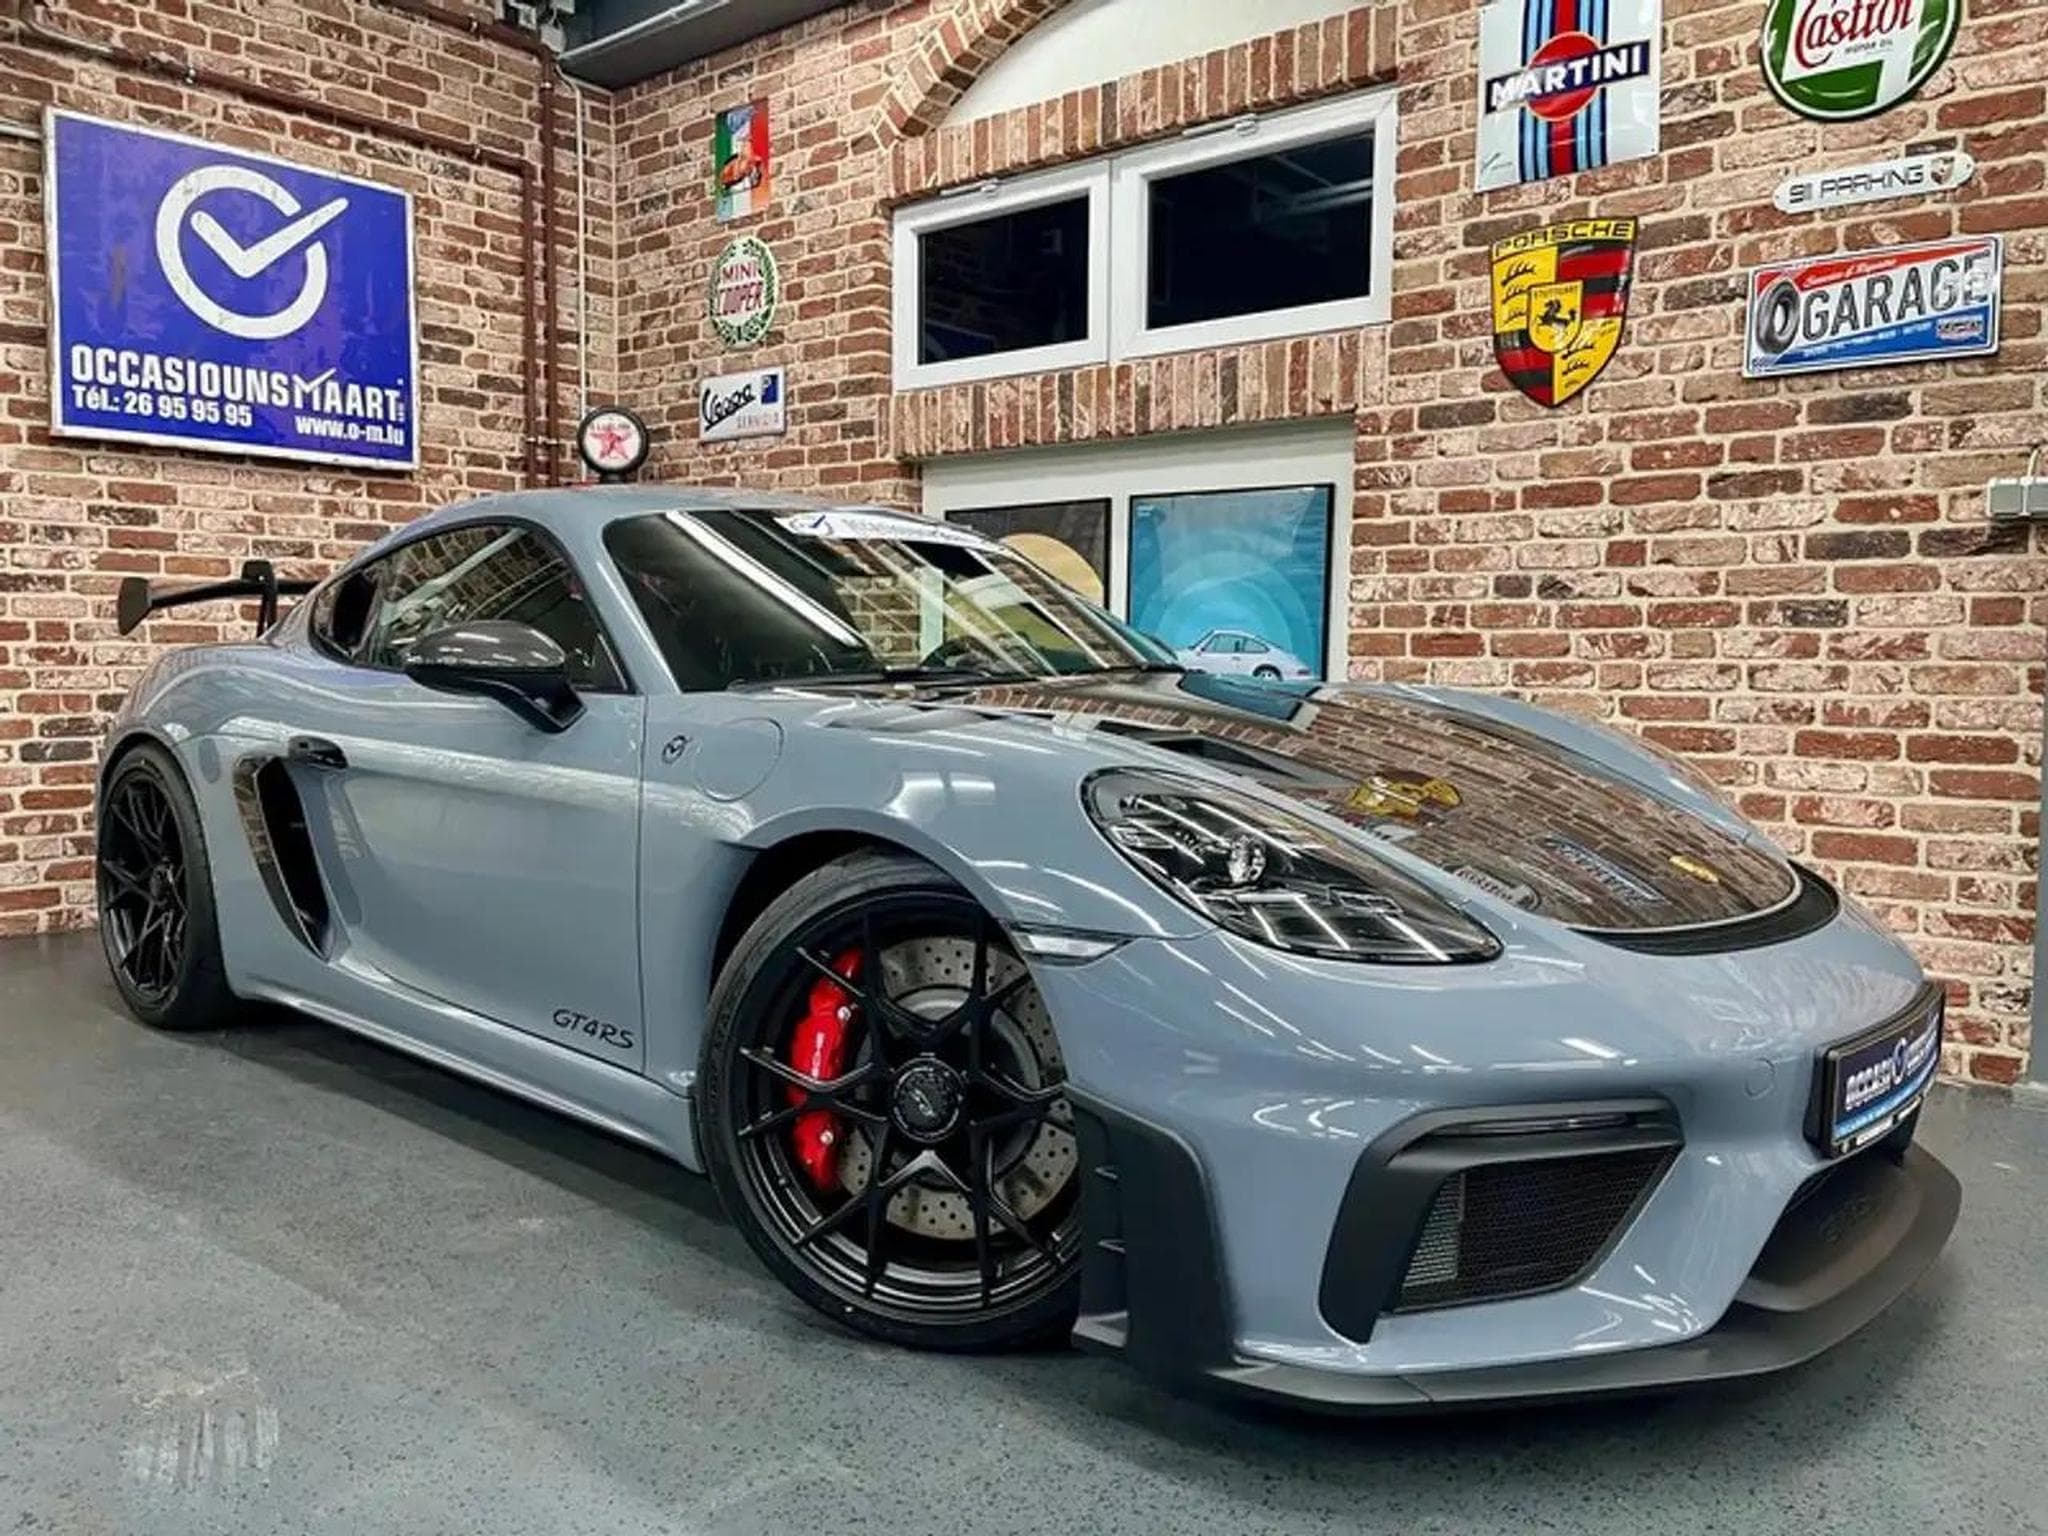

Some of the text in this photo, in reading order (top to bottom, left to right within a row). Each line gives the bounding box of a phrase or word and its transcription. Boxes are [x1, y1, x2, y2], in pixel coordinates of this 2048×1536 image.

[1491, 46, 1641, 107] MARTINI
[1820, 164, 1924, 199] PARKING
[1495, 223, 1631, 257] PORSCHE
[722, 261, 757, 281] MINI
[1803, 249, 1990, 341] GARAGE
[124, 390, 151, 416] 26
[158, 395, 187, 420] 95
[191, 398, 220, 423] 95
[225, 402, 253, 427] 95
[702, 383, 756, 432] Vespa
[295, 415, 404, 446] www.o-m.lu
